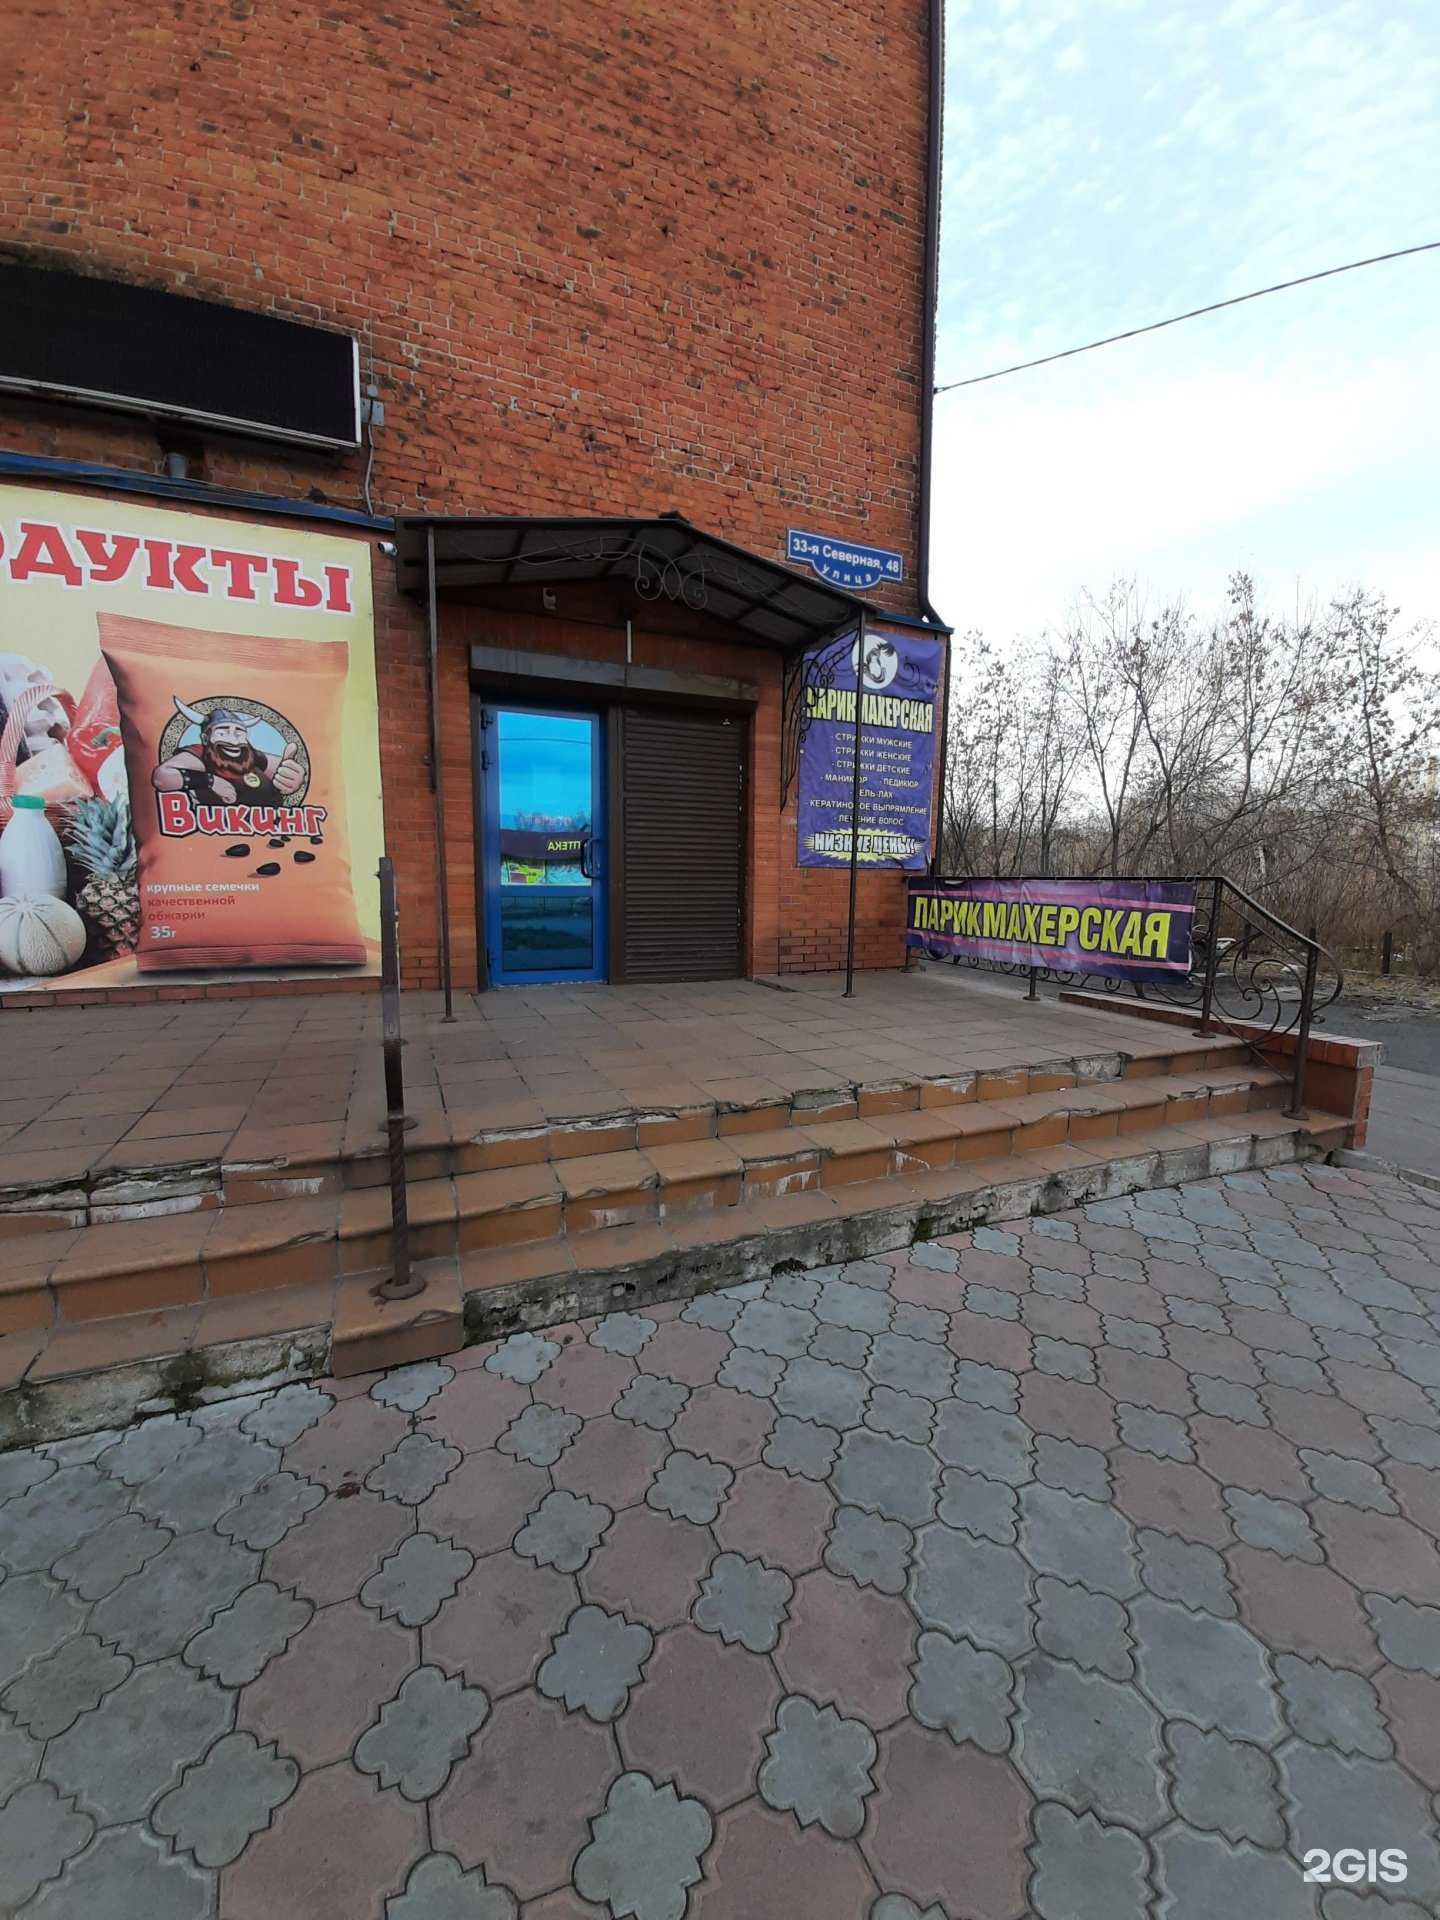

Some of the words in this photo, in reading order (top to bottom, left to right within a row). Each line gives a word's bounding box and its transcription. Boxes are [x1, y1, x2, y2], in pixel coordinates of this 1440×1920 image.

[793, 538, 820, 556] 33-я
[822, 544, 884, 571] Северная,
[886, 559, 900, 573] 48
[0, 522, 352, 613] ДУКТЫ
[822, 563, 872, 584] улица
[876, 737, 913, 749] МУЖСКИЕ
[877, 751, 912, 762] ЖЕНСКИЕ
[877, 764, 911, 775] ДЕТСКИЕ
[883, 777, 919, 788] ПЕДИКЮР
[856, 788, 893, 799] ЕЛЬ-ЛАК
[159, 790, 327, 835] Викинг
[810, 799, 870, 811] КЕРАТИНООЕ
[872, 803, 928, 815] ВЫПРЯМЛЕНИЕ
[878, 818, 905, 827] ВОЛОС
[147, 882, 203, 895] крупные
[205, 883, 260, 892] семечки
[148, 895, 236, 907] качественной
[148, 911, 206, 922] обжарки
[151, 926, 176, 939] 35г
[913, 896, 1172, 959] ПАРИКМАХЕРСКАЯ
